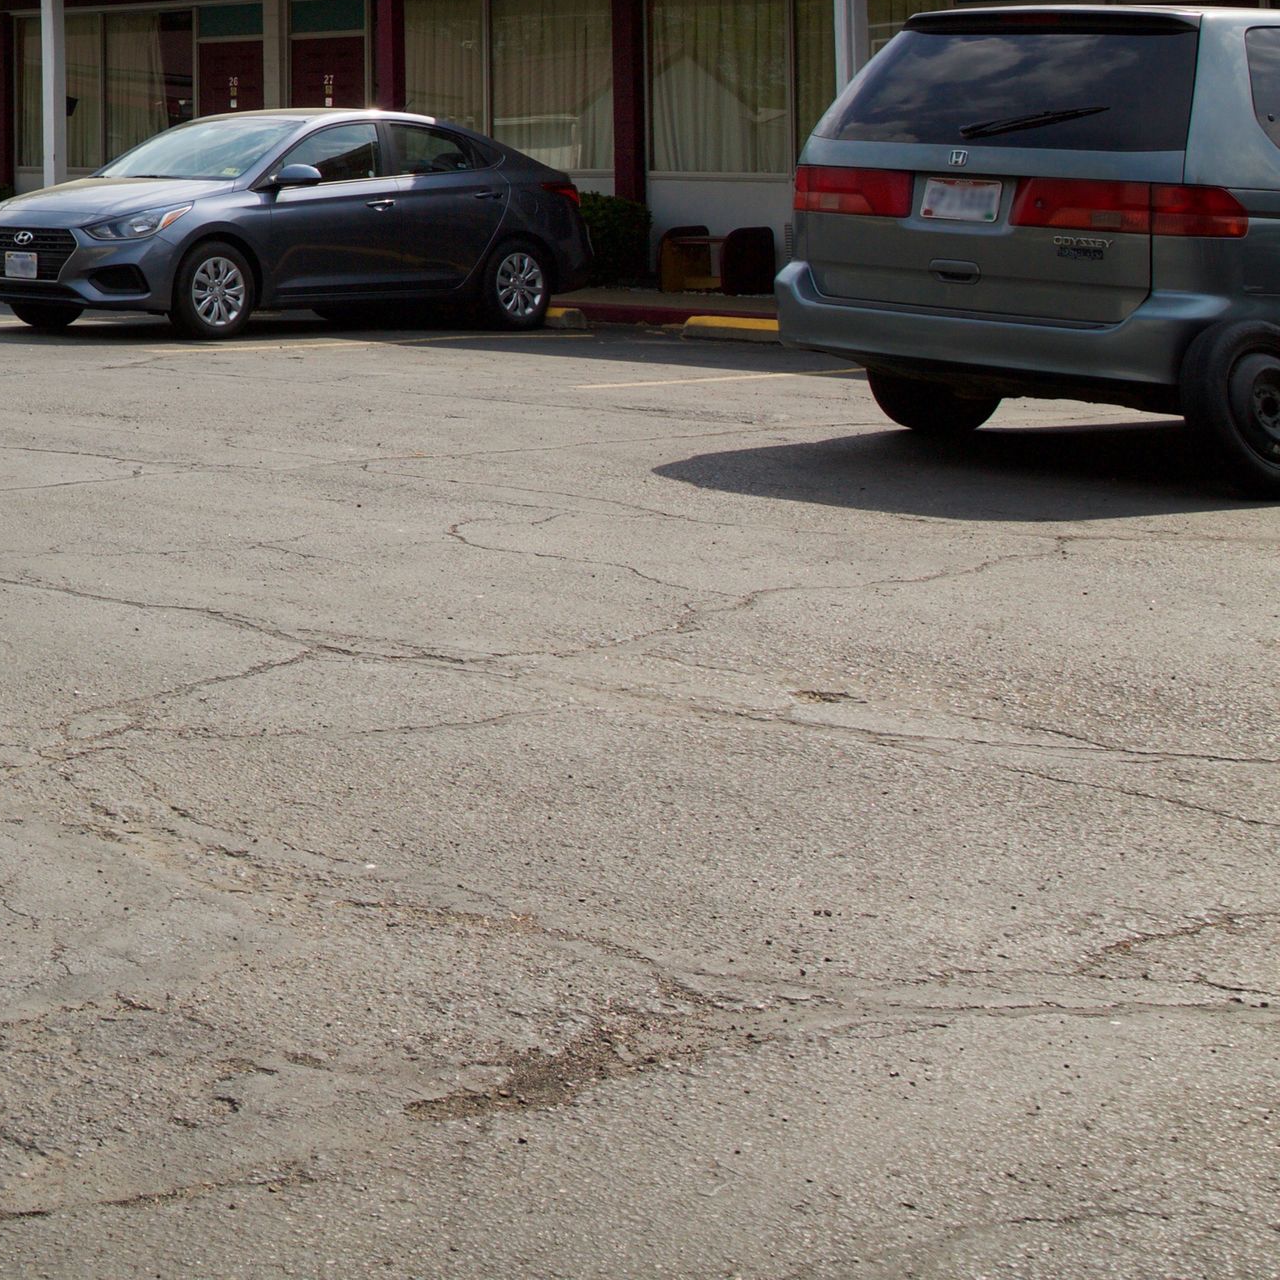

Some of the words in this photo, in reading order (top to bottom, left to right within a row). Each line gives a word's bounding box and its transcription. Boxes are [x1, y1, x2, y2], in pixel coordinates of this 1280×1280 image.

[229, 77, 238, 86] 26
[324, 75, 334, 84] 27
[1053, 236, 1113, 248] ODYSSEY
